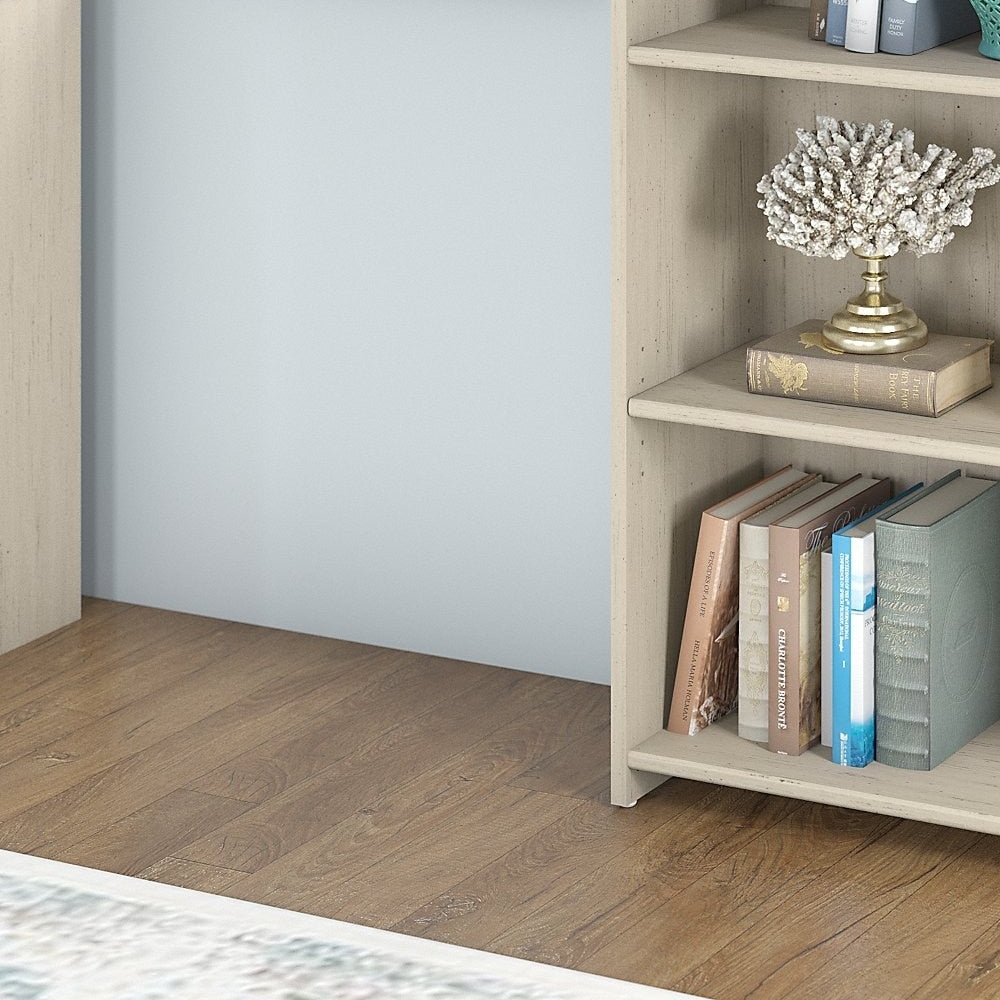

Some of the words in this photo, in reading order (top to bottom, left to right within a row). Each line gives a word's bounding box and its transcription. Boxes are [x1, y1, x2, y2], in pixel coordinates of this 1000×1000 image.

[912, 375, 921, 399] THE
[705, 550, 716, 584] EPISODES
[702, 584, 710, 594] OF
[699, 602, 707, 618] LIFE
[777, 628, 786, 688] CHARLOTTE
[687, 663, 696, 688] MARIA
[682, 688, 692, 722] HOLMAN
